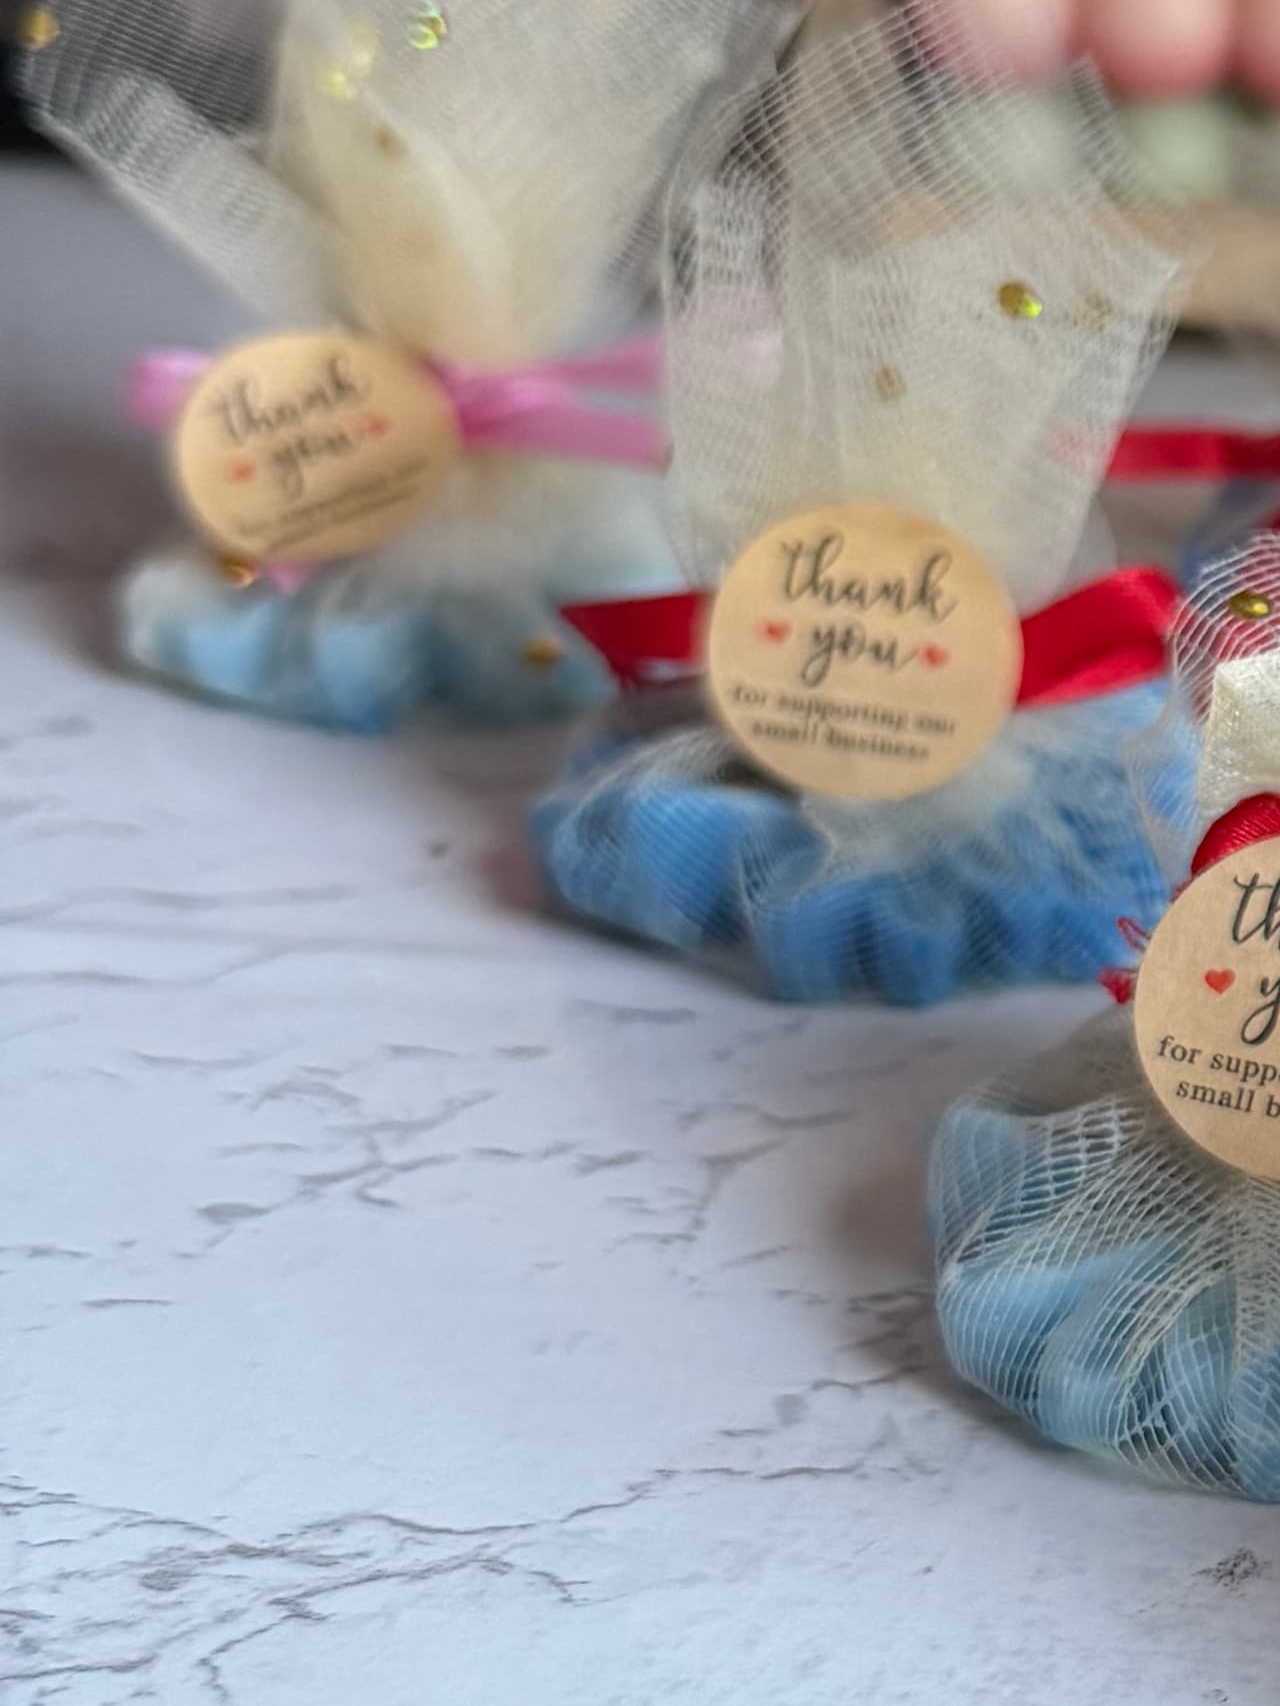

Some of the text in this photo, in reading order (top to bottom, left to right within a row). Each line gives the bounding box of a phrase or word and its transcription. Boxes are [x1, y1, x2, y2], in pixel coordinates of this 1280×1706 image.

[781, 529, 959, 624] thank
[800, 619, 919, 688] you
[1156, 1035, 1202, 1065] for
[1176, 1079, 1254, 1113] small
